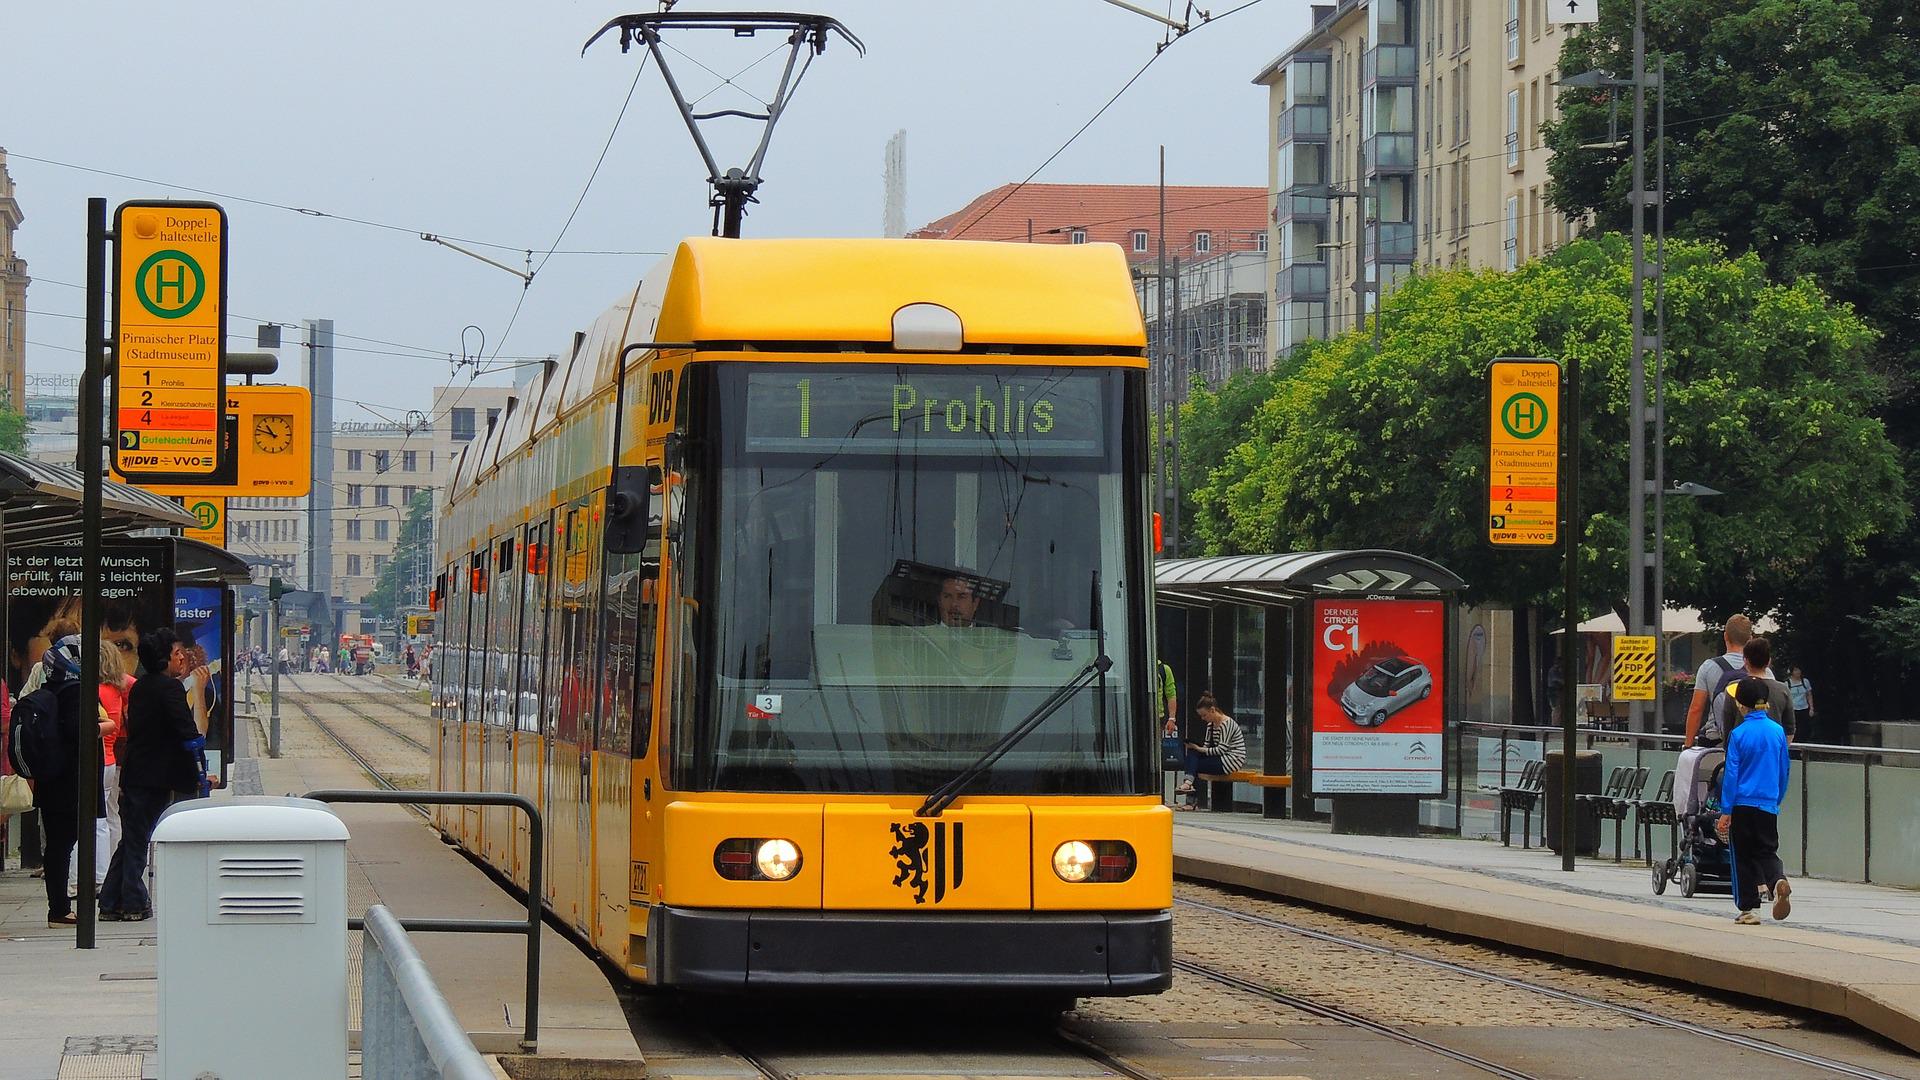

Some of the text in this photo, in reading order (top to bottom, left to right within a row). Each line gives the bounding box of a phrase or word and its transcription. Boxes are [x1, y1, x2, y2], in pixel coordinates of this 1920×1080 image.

[166, 217, 212, 231] Doppel-
[160, 231, 218, 242] haltestelle
[122, 333, 216, 345] Pirnaischer Platz
[126, 349, 211, 361] (Stadtmuseum)
[143, 370, 185, 387] 1 Prohlis
[1521, 370, 1552, 378] Doppel-
[25, 374, 78, 387] Dresden
[141, 390, 152, 406] 2
[649, 369, 674, 425] DVB
[797, 378, 1055, 438] 1 Prohlis
[141, 410, 152, 425] 4
[1493, 448, 1555, 457] Pirnaischer Platz
[134, 456, 159, 465] DVB
[173, 456, 200, 466] VVO
[1495, 460, 1552, 468] (Stadtmuseum)
[1506, 474, 1512, 485] 1
[1505, 488, 1513, 499] 2
[1505, 502, 1513, 513] 4
[8, 556, 22, 566] st
[26, 556, 49, 566] der
[54, 556, 83, 567] letzt
[100, 556, 150, 567] Wunsch
[10, 570, 53, 583] erfüllt,
[110, 571, 162, 584] leichter,
[101, 586, 143, 599] agen.“
[1323, 608, 1358, 616] DER NEUE
[1323, 616, 1359, 624] CITROËN
[1323, 624, 1359, 651] C1
[1624, 663, 1643, 672] FDP
[764, 697, 773, 710] 3
[633, 863, 647, 891] 2721
